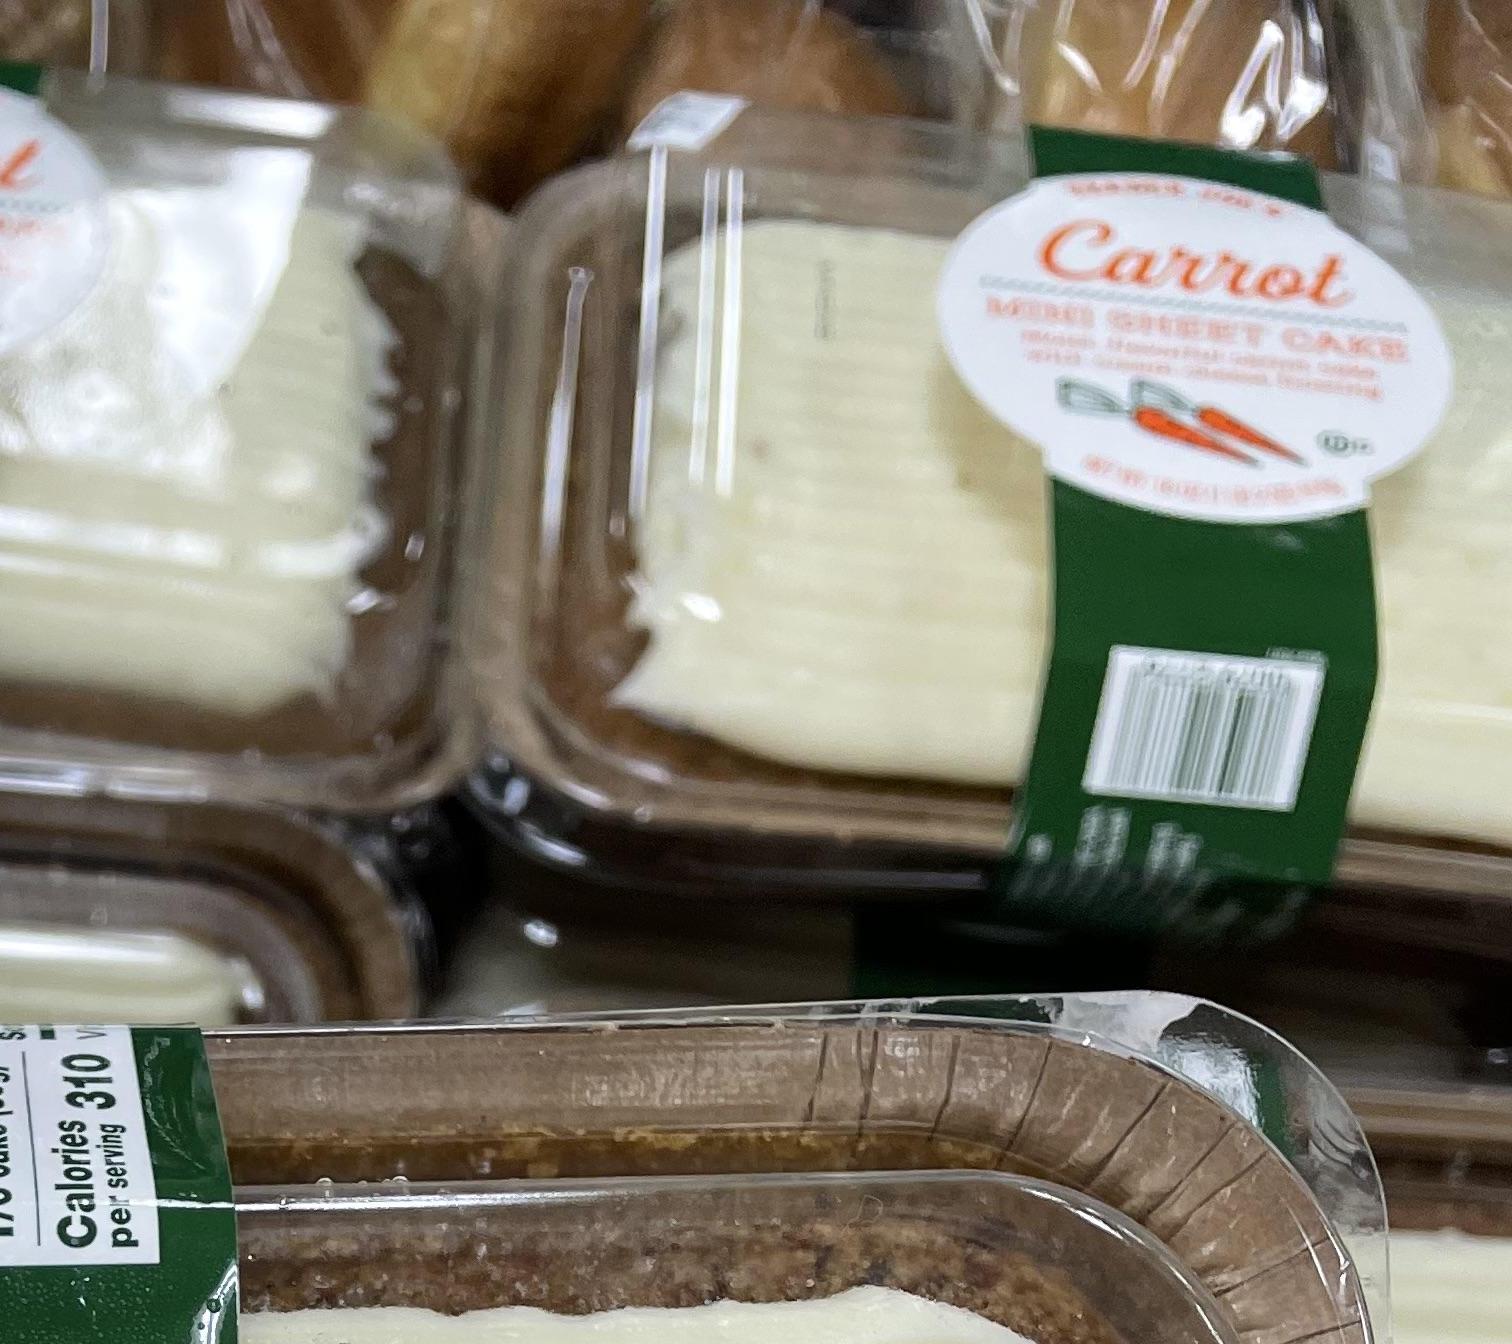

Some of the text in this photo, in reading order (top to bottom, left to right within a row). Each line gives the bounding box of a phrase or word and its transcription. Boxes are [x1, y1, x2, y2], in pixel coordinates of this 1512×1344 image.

[1040, 218, 1357, 306] Carrot
[62, 1054, 115, 1109] 310
[52, 1120, 97, 1249] Calories
[96, 1125, 139, 1248] per serving
